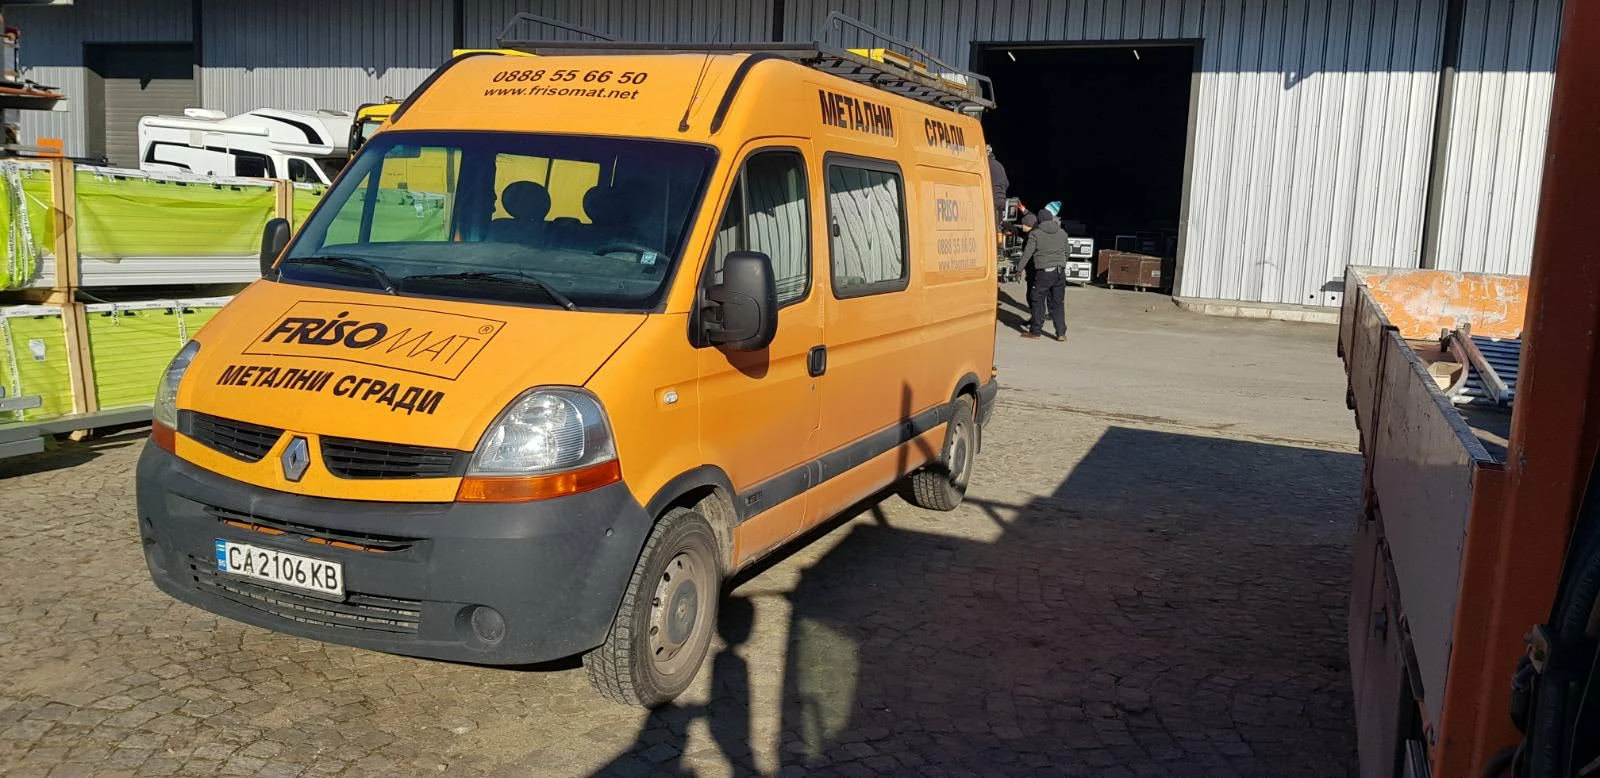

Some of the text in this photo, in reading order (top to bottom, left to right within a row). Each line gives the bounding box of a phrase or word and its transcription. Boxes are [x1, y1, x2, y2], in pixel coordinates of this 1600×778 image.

[484, 85, 639, 100] www.frisomat.net
[493, 69, 648, 85] 0888 55 66 50
[818, 89, 894, 138] МЕТАЛНИ
[216, 365, 445, 415] МЕТАЛНИ СГРАДИ
